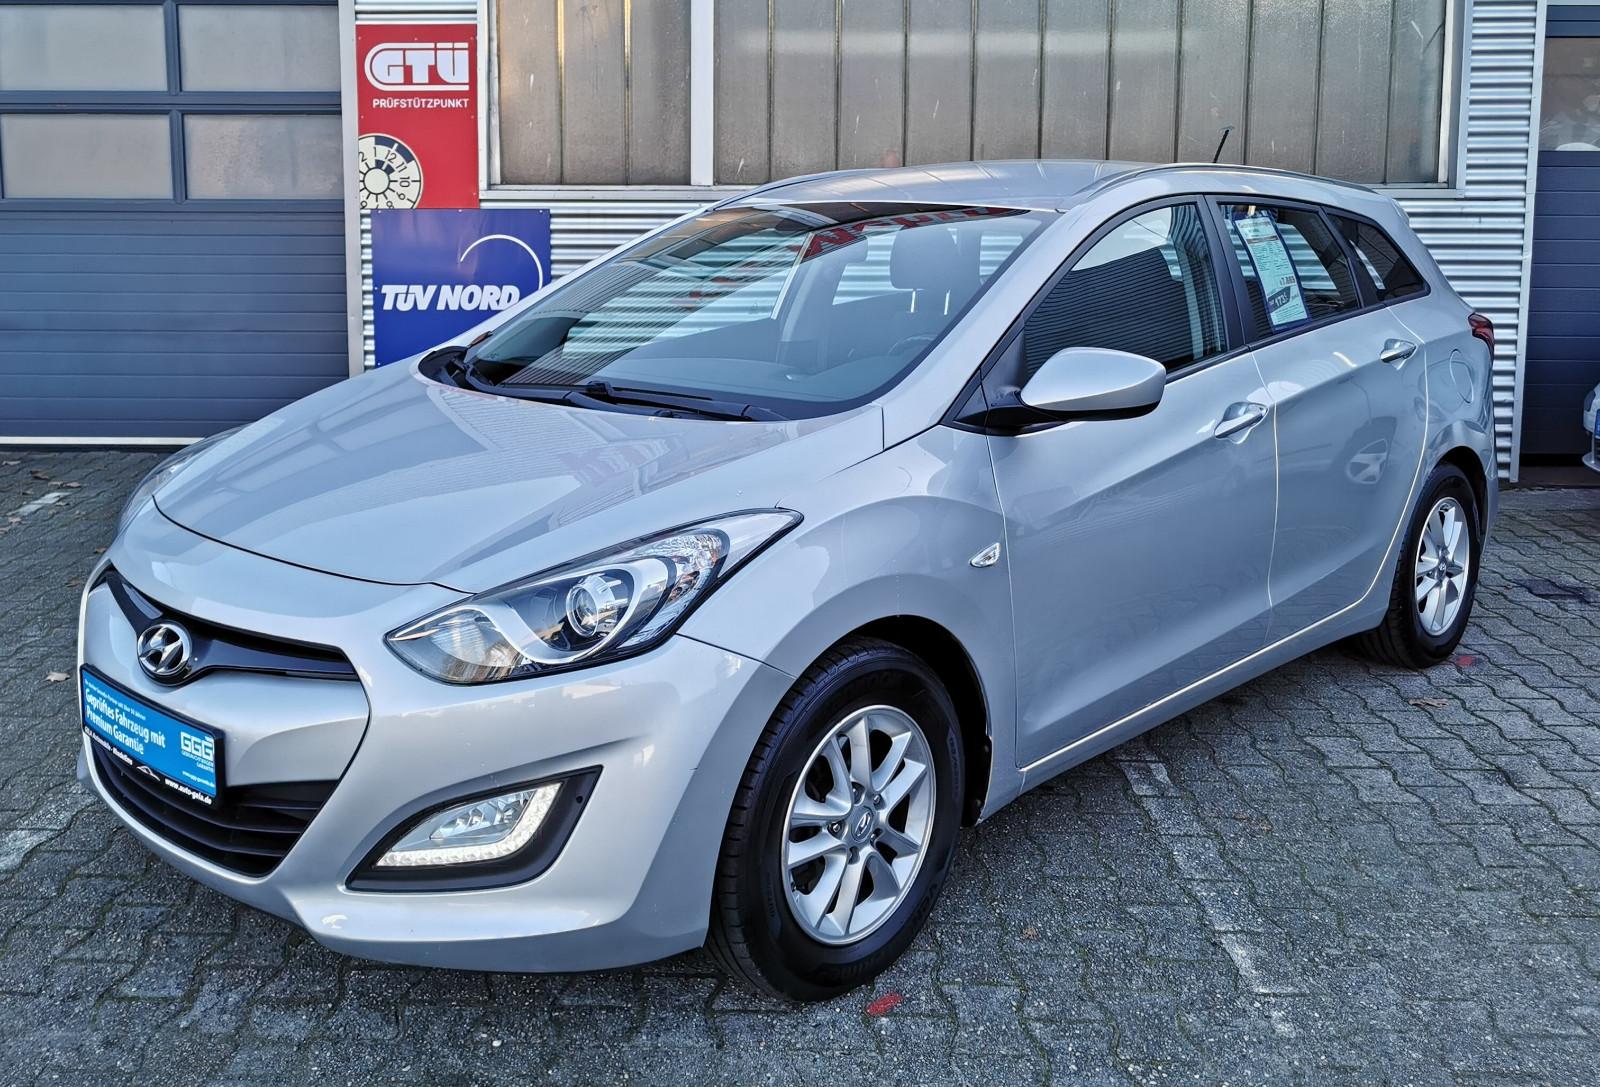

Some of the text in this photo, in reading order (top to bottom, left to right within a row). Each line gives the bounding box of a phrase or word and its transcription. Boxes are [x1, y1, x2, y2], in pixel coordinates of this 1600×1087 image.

[366, 43, 470, 88] GTÜ
[372, 97, 470, 109] PRÜFSTÜTZPUNKT
[385, 150, 397, 164] 12
[395, 161, 408, 173] 11
[399, 176, 411, 188] 10
[381, 285, 520, 311] TÜV NORD
[85, 689, 115, 721] Geprüftes
[115, 711, 150, 743] Fahrzeug
[151, 729, 166, 748] mit
[86, 706, 113, 735] Premium
[113, 728, 144, 755] Garantie
[181, 731, 214, 760] GGG
